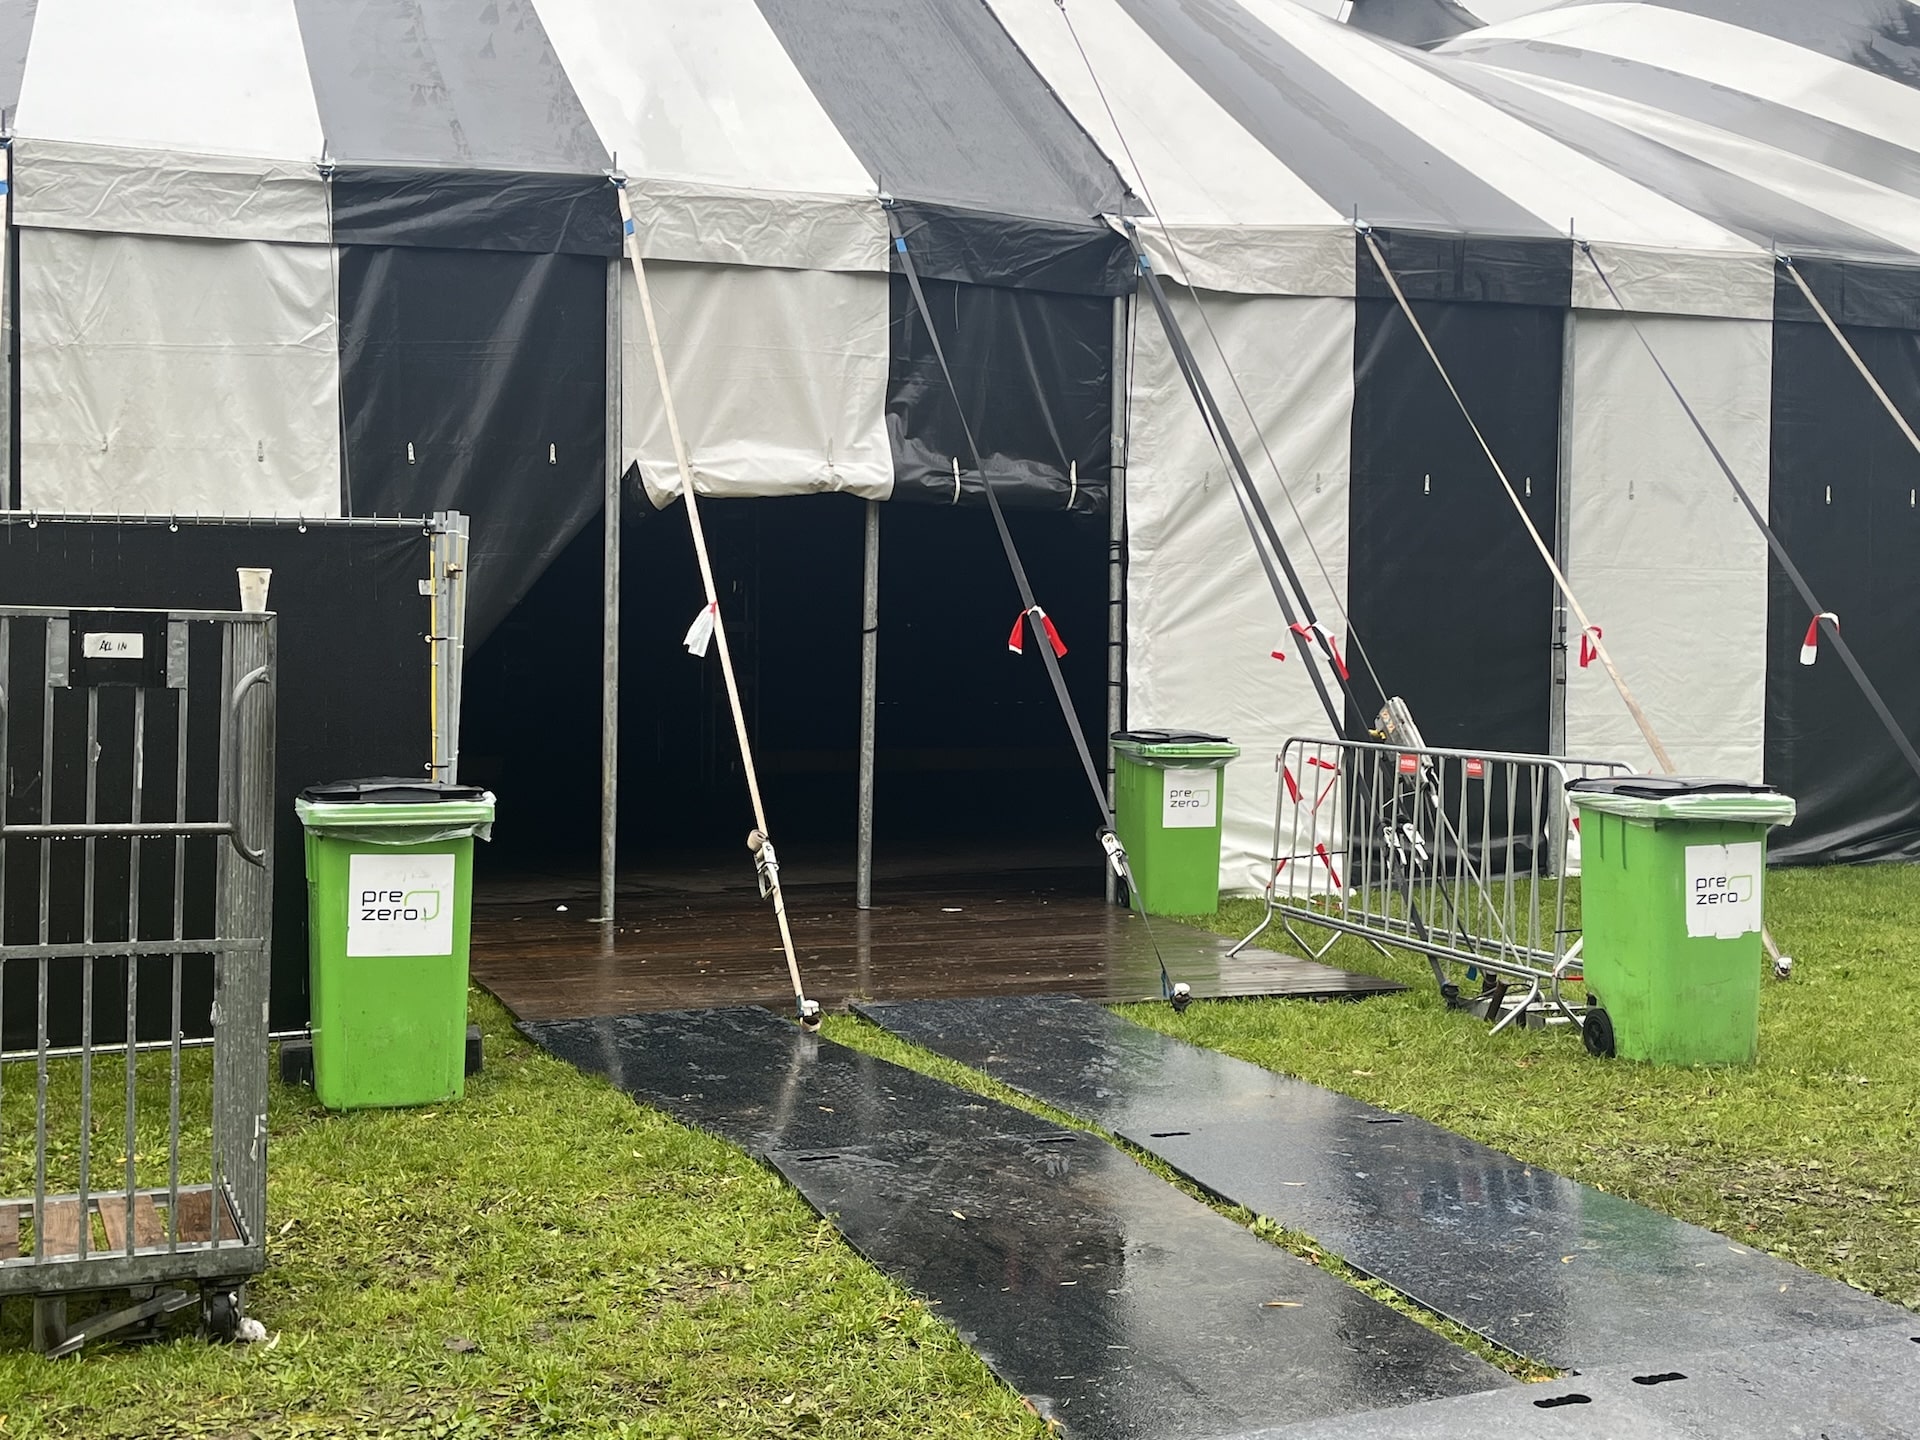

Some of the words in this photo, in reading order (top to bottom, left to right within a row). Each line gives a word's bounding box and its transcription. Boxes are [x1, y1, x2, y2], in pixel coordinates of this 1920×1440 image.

[117, 642, 128, 651] IN
[1170, 789, 1192, 799] pre
[1170, 800, 1200, 808] zero
[1695, 876, 1727, 892] pre
[362, 890, 403, 906] pre
[1696, 892, 1738, 905] zero
[361, 909, 418, 921] zero
